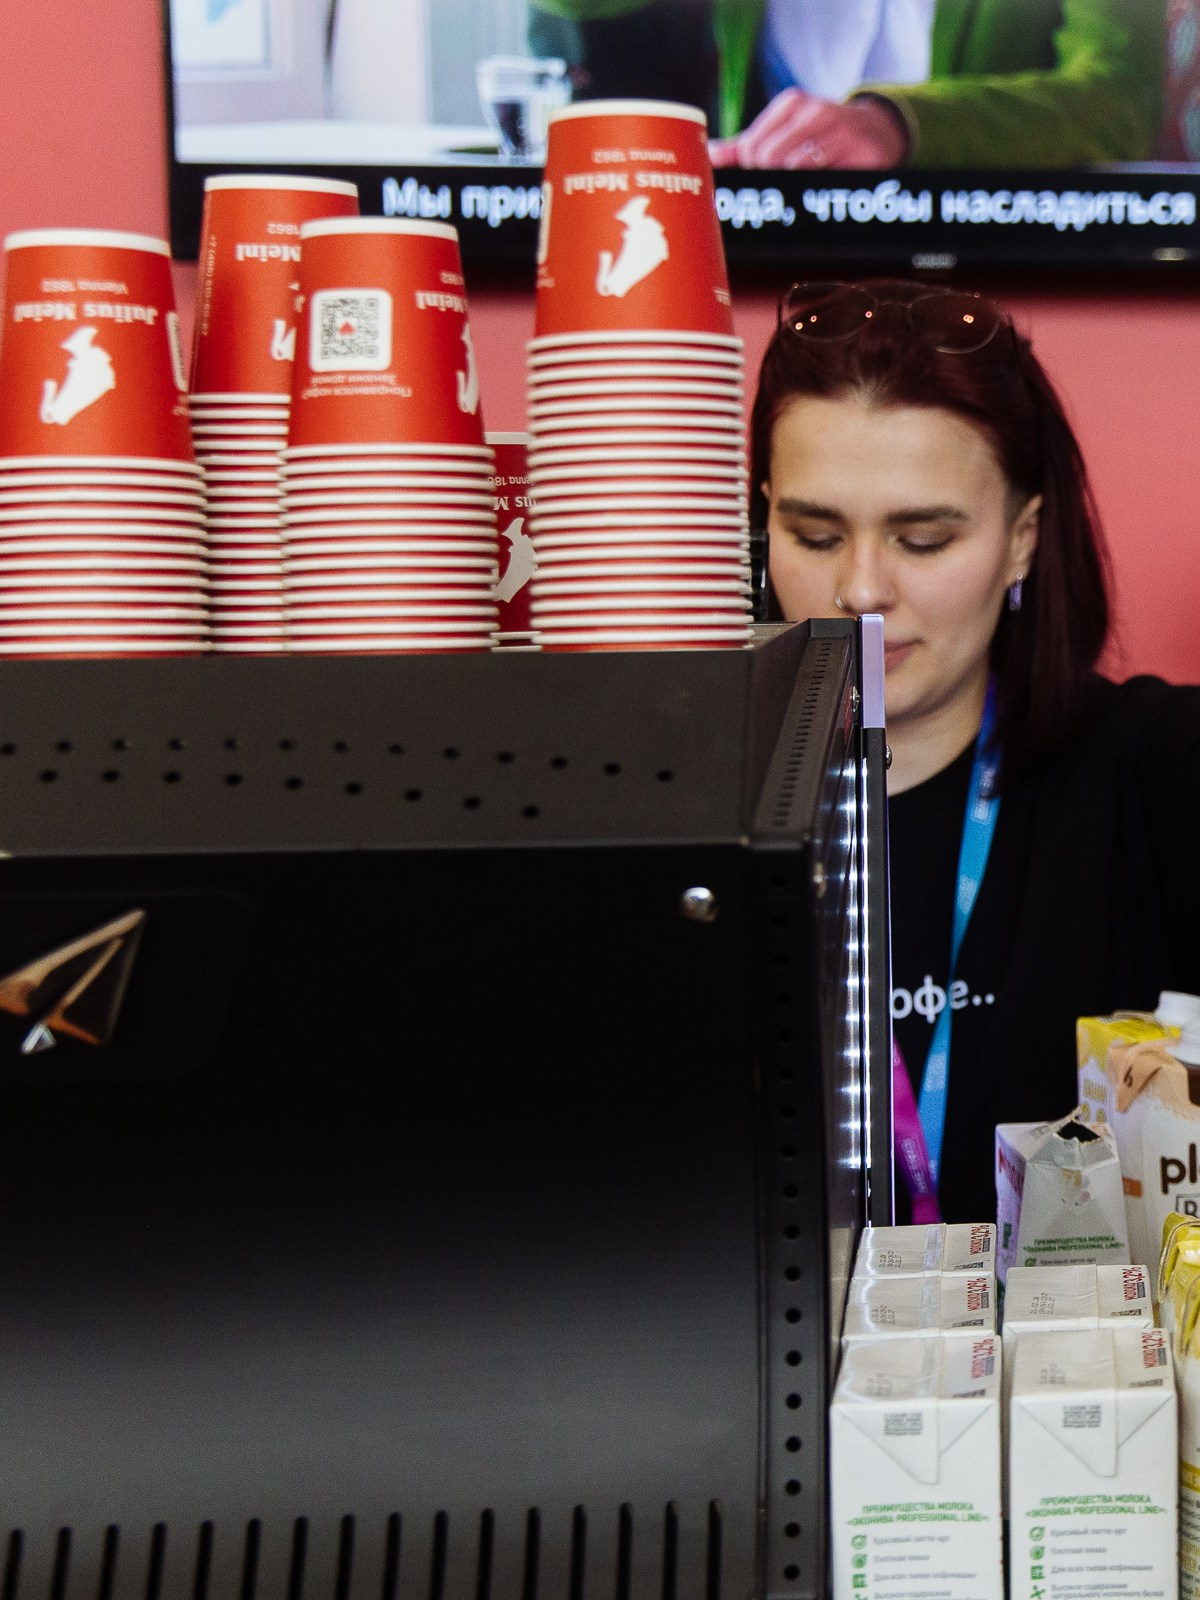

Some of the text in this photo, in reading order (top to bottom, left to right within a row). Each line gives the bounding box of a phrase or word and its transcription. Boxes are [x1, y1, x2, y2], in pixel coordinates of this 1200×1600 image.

[563, 173, 703, 196] Julius Meinl
[382, 177, 452, 219] Мы
[461, 186, 544, 227] при
[804, 181, 934, 224] чтобы
[941, 189, 1196, 232] насладиться
[13, 301, 158, 325] Julius Meinl
[896, 1513, 959, 1522] PROFESSIONAL
[1073, 1505, 1136, 1514] PROFESSIONAL
